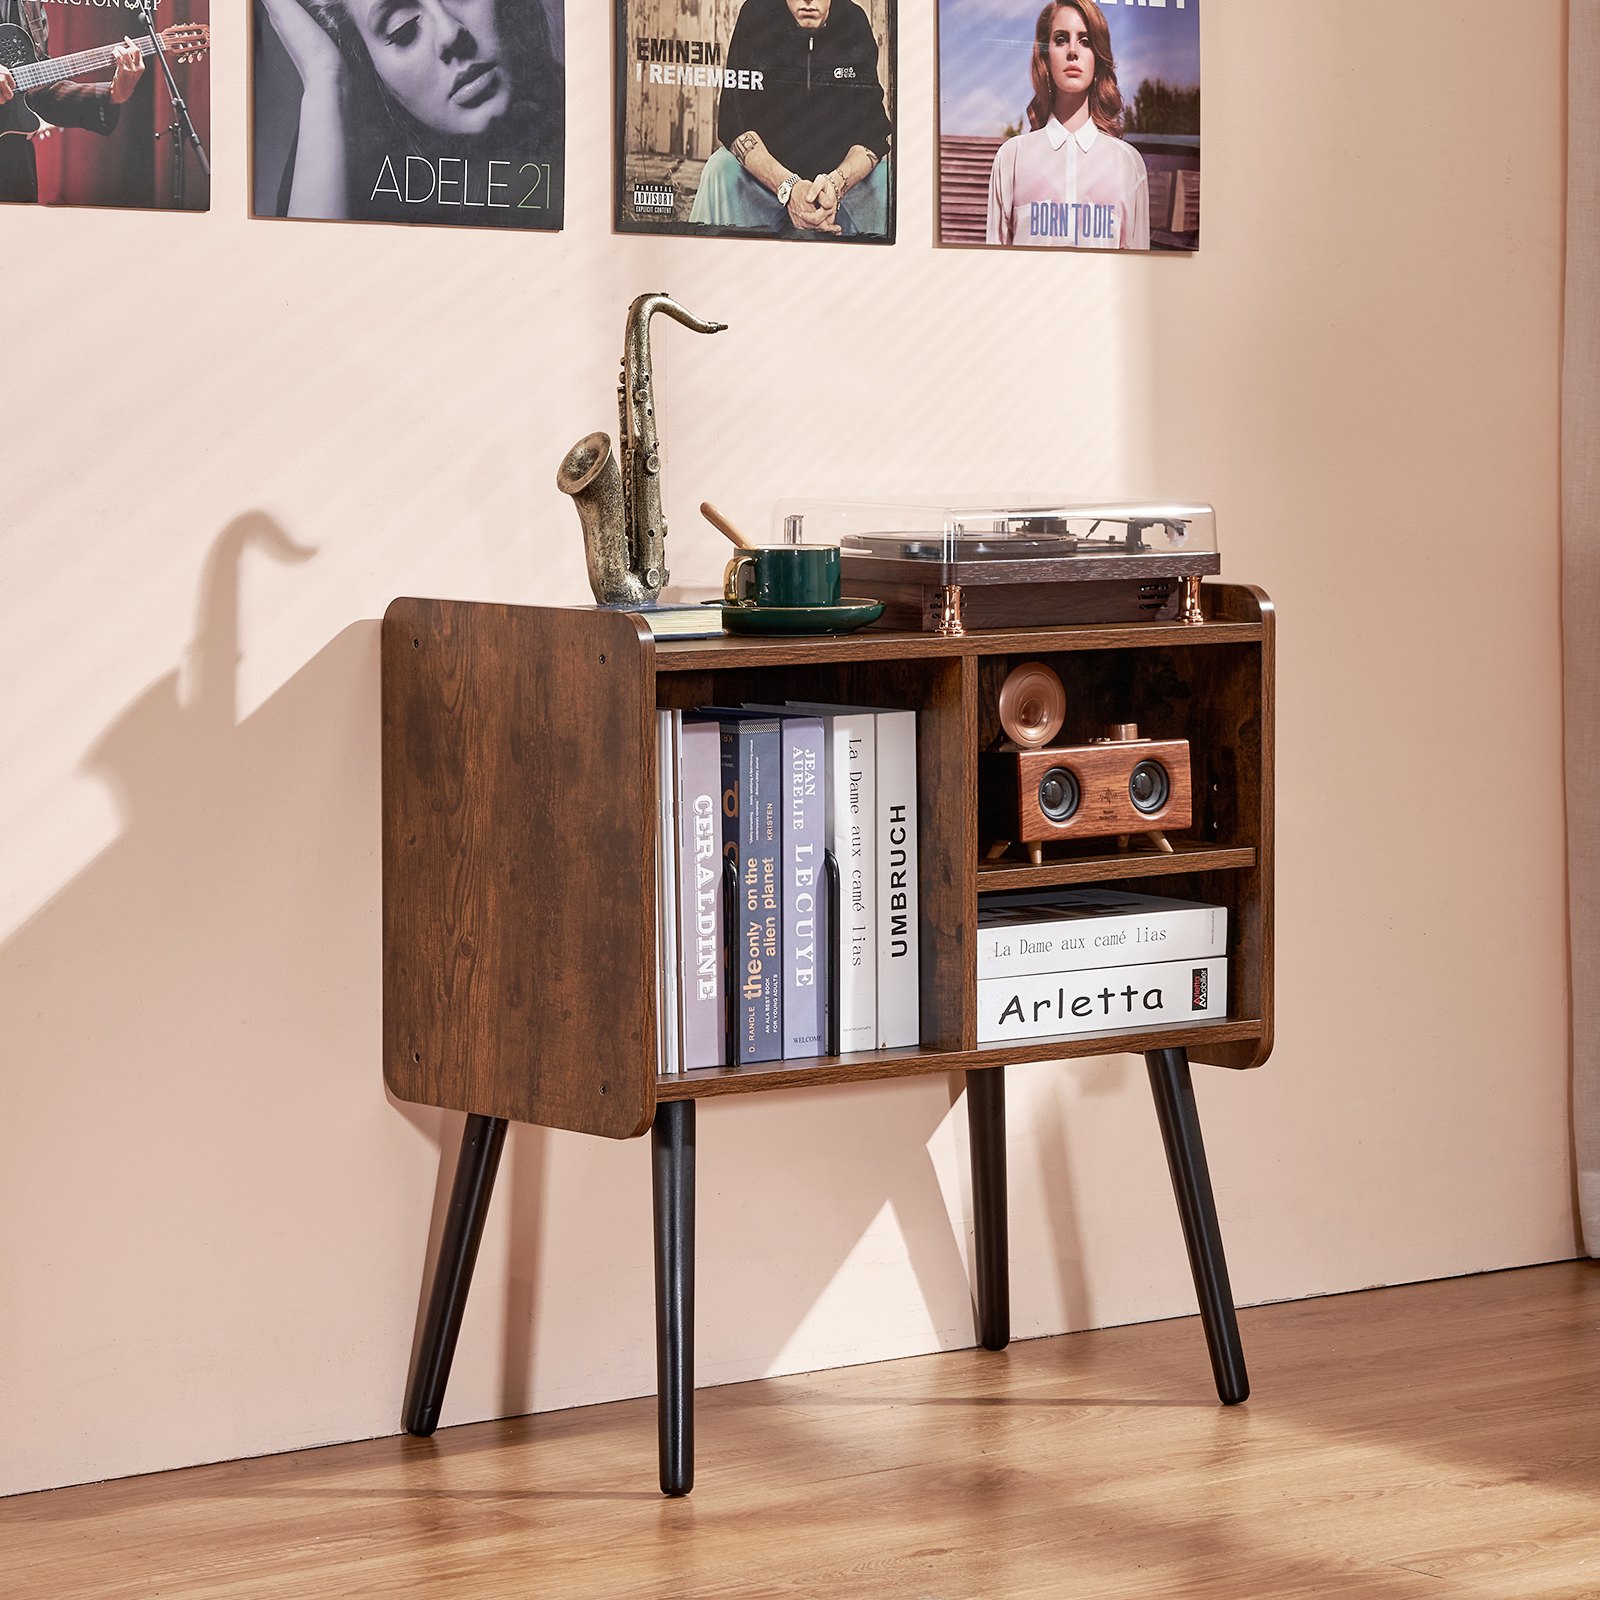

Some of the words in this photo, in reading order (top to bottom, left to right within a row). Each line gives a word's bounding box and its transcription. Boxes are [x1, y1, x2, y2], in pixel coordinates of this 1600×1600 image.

[636, 37, 720, 66] EMINEM
[636, 63, 643, 82] I
[649, 64, 764, 91] REMEMBER
[370, 155, 510, 207] ADELE
[517, 163, 550, 209] 21
[635, 193, 672, 205] ADVISORY
[1030, 202, 1068, 237] BORN
[1072, 204, 1091, 246] TO
[1094, 205, 1115, 239] DIE
[849, 739, 861, 760] La
[793, 746, 804, 830] AURELIE
[804, 749, 816, 796] JEAN
[850, 771, 862, 814] Dame
[766, 802, 774, 841] KRISTEN
[851, 826, 861, 857] aux
[745, 858, 758, 885] the
[762, 857, 777, 909] planet
[852, 869, 866, 912] camé
[890, 804, 907, 958] UMBRUCH
[748, 889, 758, 911] on
[795, 843, 814, 987] LECUYE
[747, 922, 762, 958] only
[763, 917, 777, 957] alien
[852, 927, 866, 966] lias
[995, 942, 1011, 957] La
[1020, 939, 1053, 955] Dame
[1061, 937, 1085, 951] aux
[1094, 931, 1126, 948] camé
[1136, 927, 1167, 943] lias
[743, 960, 762, 1000] the
[748, 1006, 756, 1041] RANDLE
[998, 985, 1165, 1025] Arletta
[748, 1044, 756, 1053] D.
[765, 1024, 771, 1034] AN
[793, 1035, 822, 1044] WELCOME
